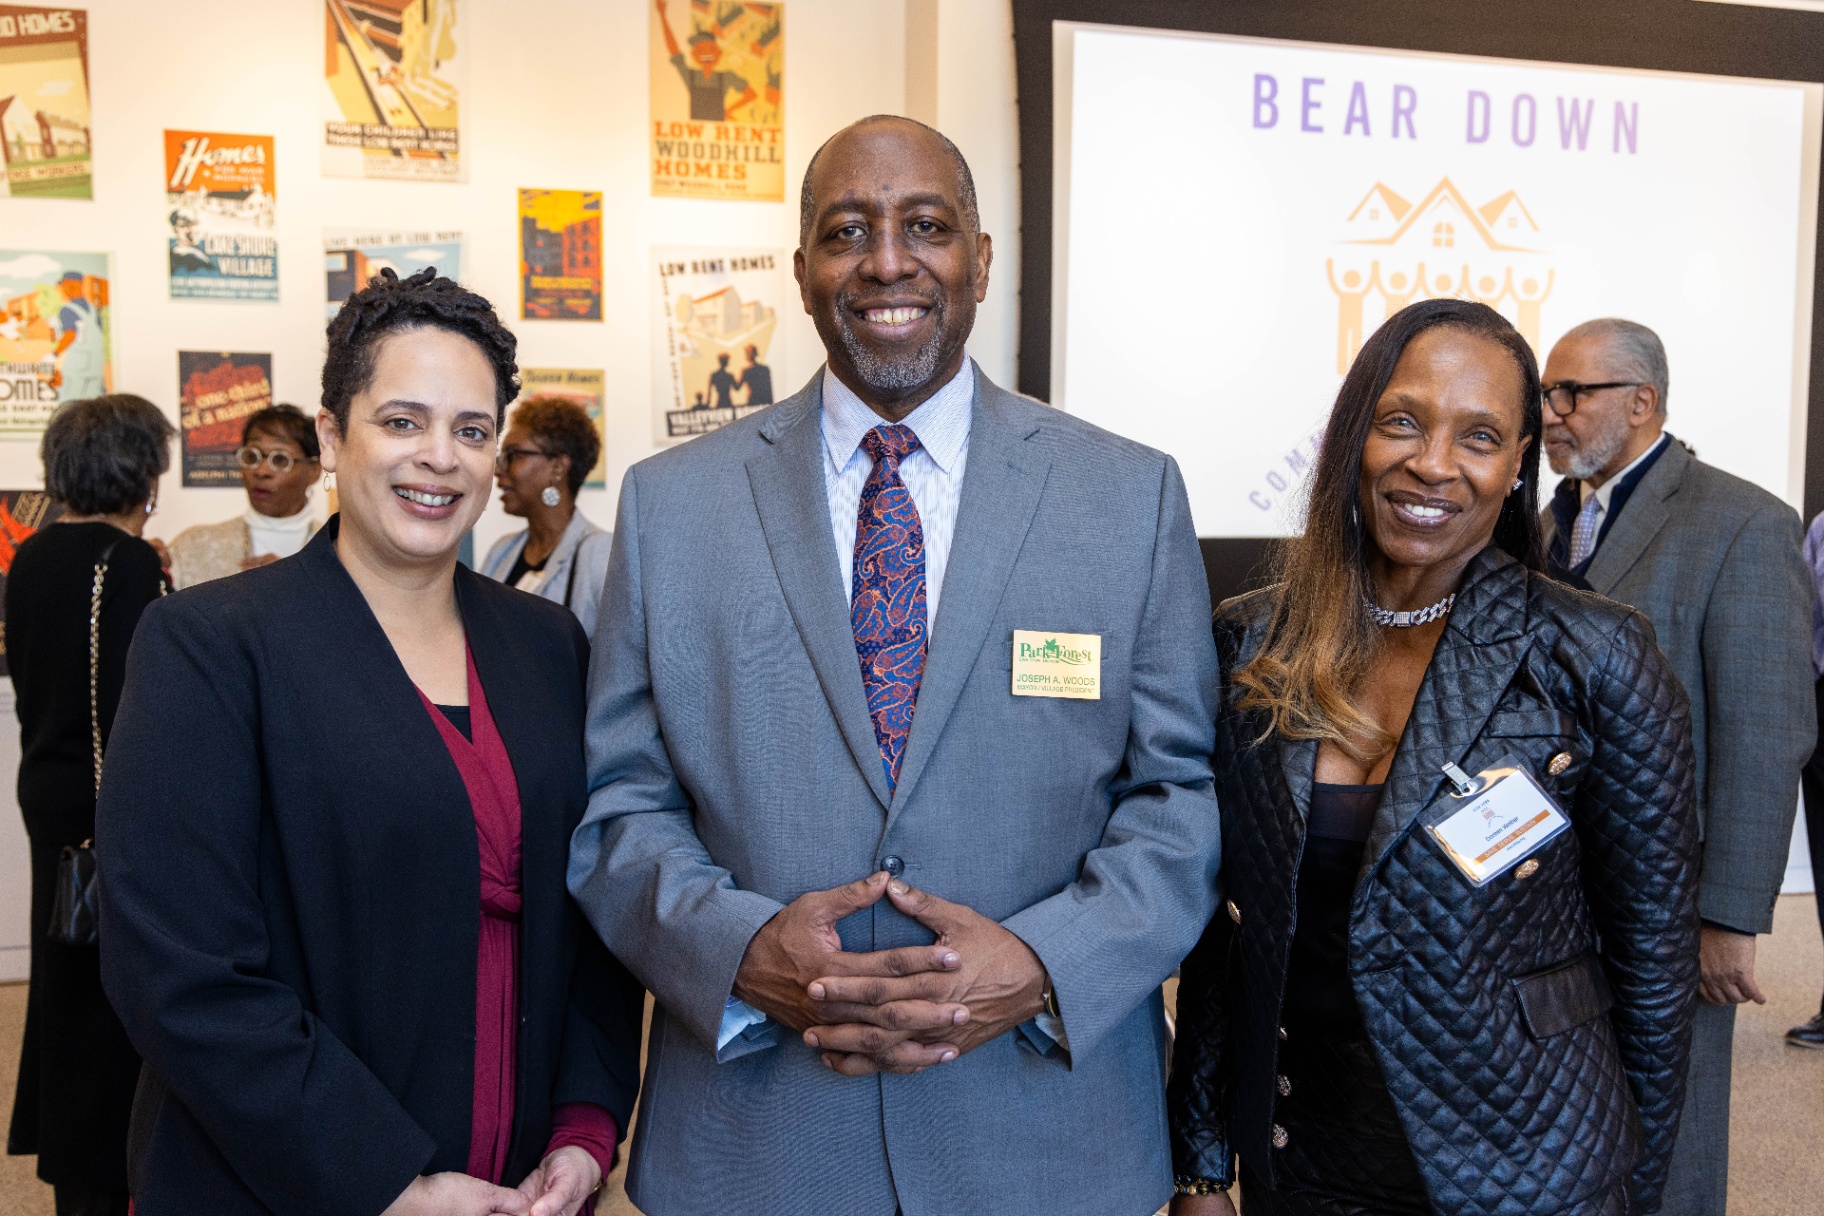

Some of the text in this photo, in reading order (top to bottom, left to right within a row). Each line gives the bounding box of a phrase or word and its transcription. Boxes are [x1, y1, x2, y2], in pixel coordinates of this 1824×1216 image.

[17, 11, 76, 36] HOMES
[1252, 73, 1639, 155] BEAR DOWN
[655, 121, 782, 143] LOW RENT
[656, 139, 782, 163] WOODHILL
[656, 160, 746, 180] HOMES
[660, 255, 775, 277] LOW RENT HOMES
[1020, 642, 1092, 662] Park Forest
[1016, 674, 1096, 686] JOSEPH A. WOODS
